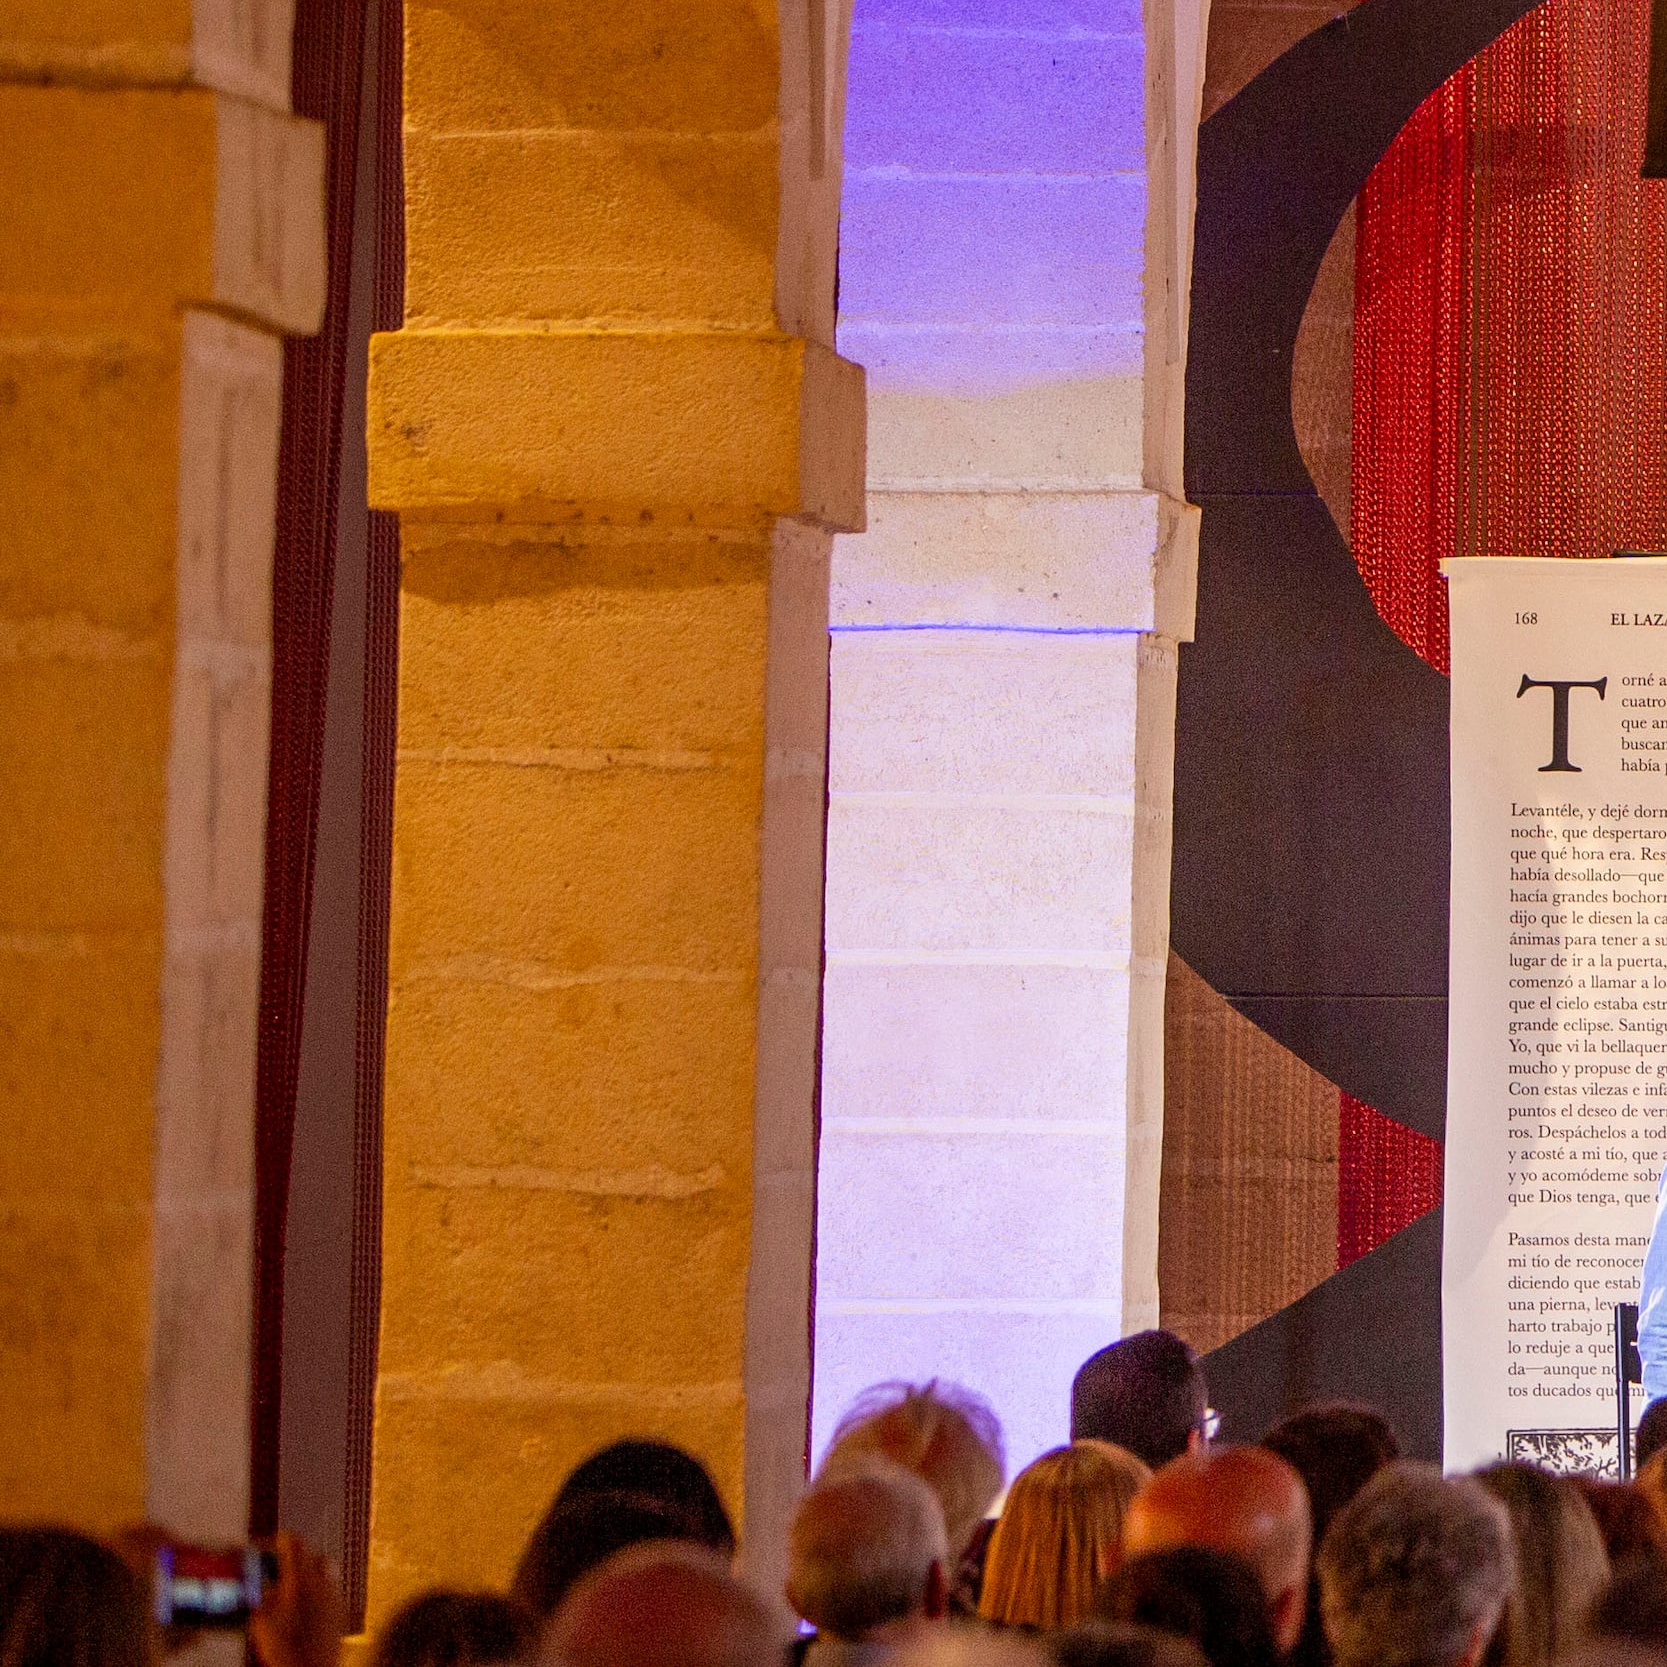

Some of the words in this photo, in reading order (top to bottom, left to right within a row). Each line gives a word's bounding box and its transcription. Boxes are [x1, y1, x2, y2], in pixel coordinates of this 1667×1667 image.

[1515, 611, 1538, 625] 168
[1611, 613, 1630, 626] EL
[1622, 673, 1654, 686] orné
[1659, 677, 1667, 686] a
[1510, 888, 1548, 902] hacía
[1552, 889, 1608, 907] grandes
[1509, 1082, 1539, 1096] Con
[1544, 1085, 1577, 1096] estas
[1582, 1082, 1628, 1096] vilezas
[1632, 1087, 1640, 1096] e
